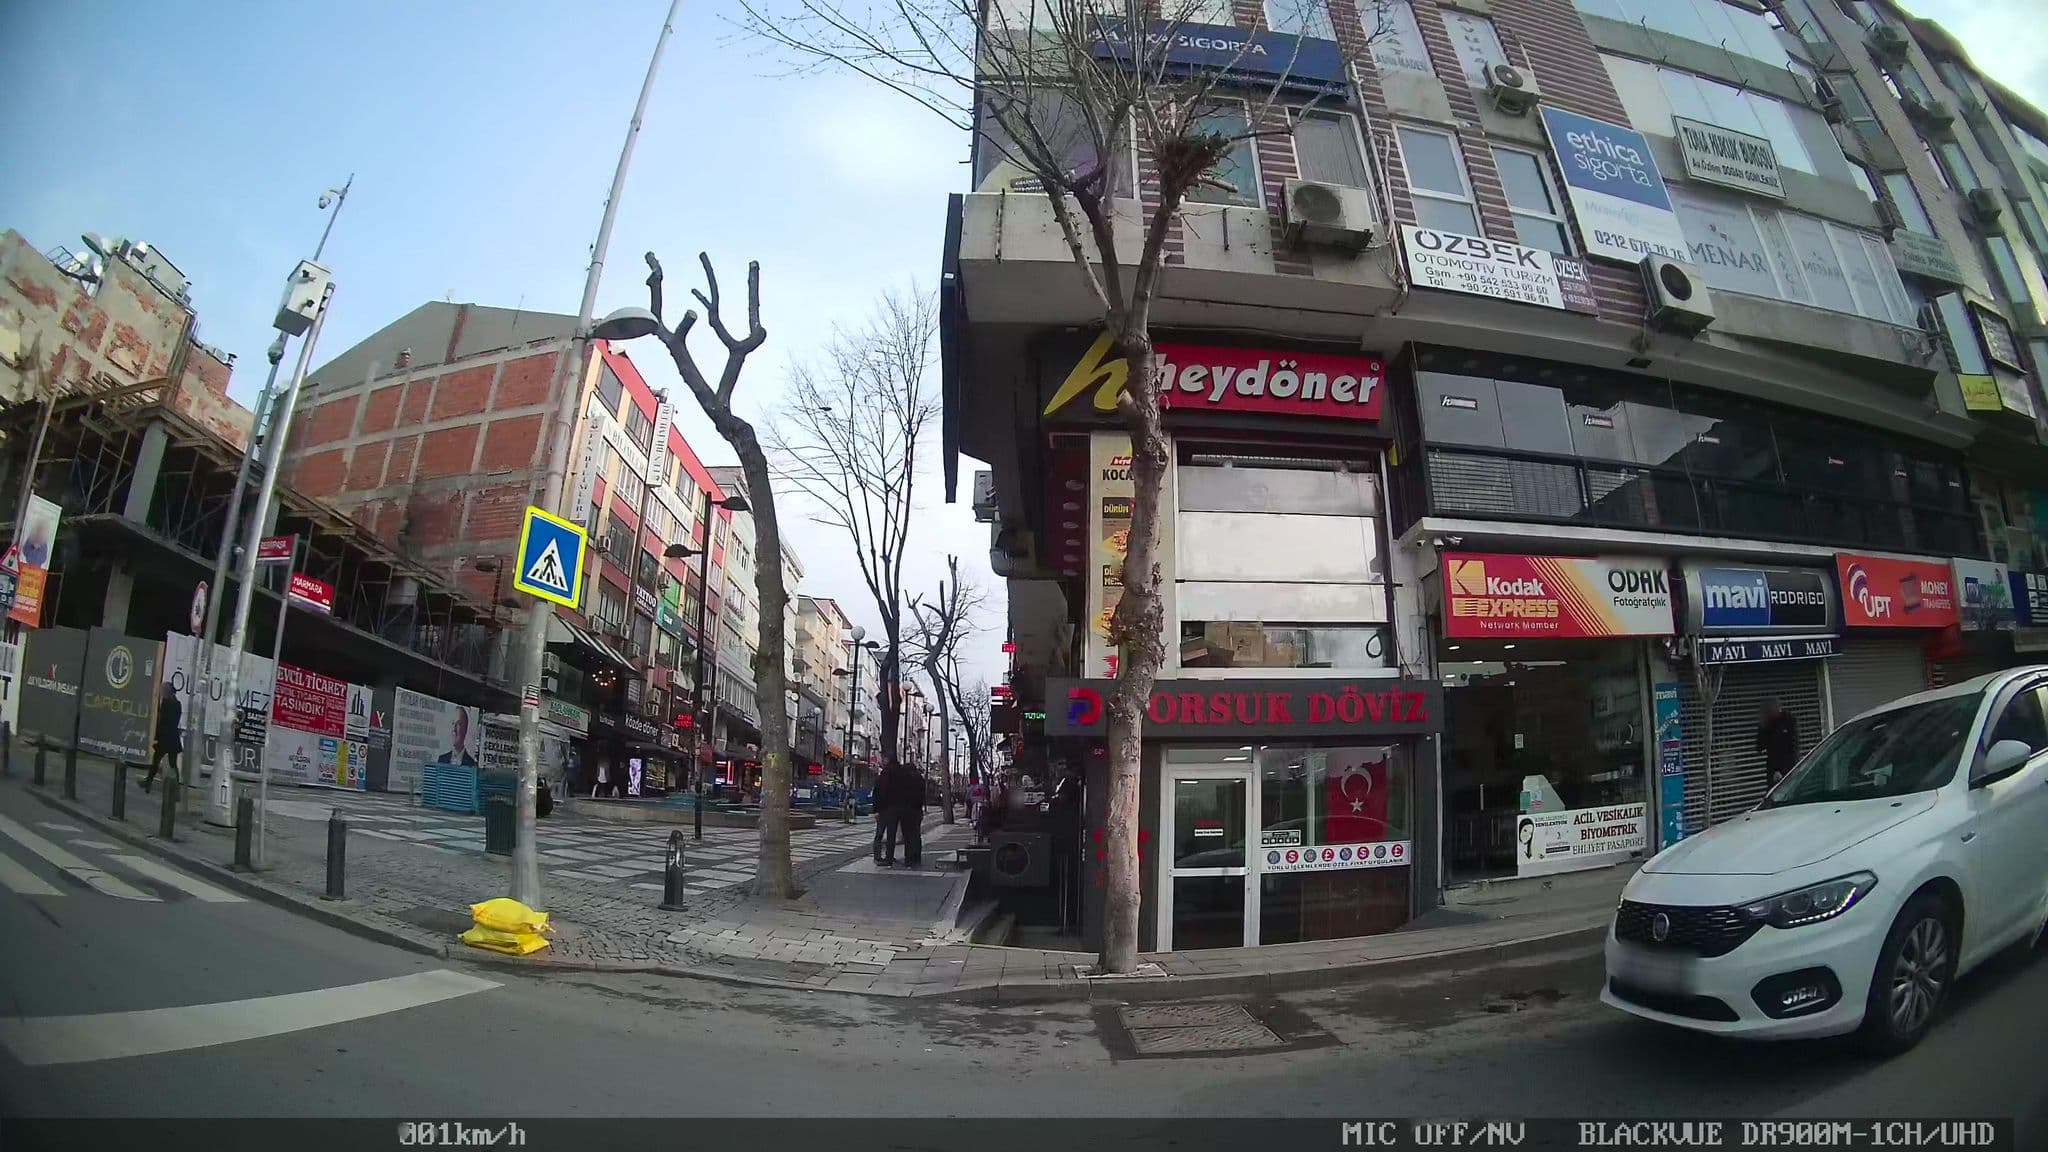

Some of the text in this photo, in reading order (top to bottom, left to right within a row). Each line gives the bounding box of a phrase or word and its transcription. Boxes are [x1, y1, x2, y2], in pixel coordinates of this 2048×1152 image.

[1566, 130, 1645, 166] ethica
[1574, 149, 1653, 187] sigorta
[1414, 229, 1541, 270] ÖZBEK
[1594, 229, 1628, 250] 0212
[1686, 241, 1769, 273] MENAR
[1482, 285, 1501, 296] 212
[1153, 353, 1379, 405] heydöner
[293, 577, 323, 595] MARMARA
[1487, 577, 1546, 597] Kodak
[1607, 568, 1669, 595] ODAK
[1705, 578, 1825, 609] mavi RODRIGO
[1920, 580, 1949, 595] MONEY
[636, 584, 657, 607] TATTOO
[1861, 588, 1892, 619] UPT
[1453, 598, 1560, 618] EXPRESS
[1479, 620, 1520, 630] Network
[306, 672, 347, 697] TİCARET
[1148, 685, 1429, 725] ORSUK DÖVİZ
[1573, 806, 1644, 825] ACİL VESİKALIK
[1580, 823, 1638, 841] BİYOMETRİK
